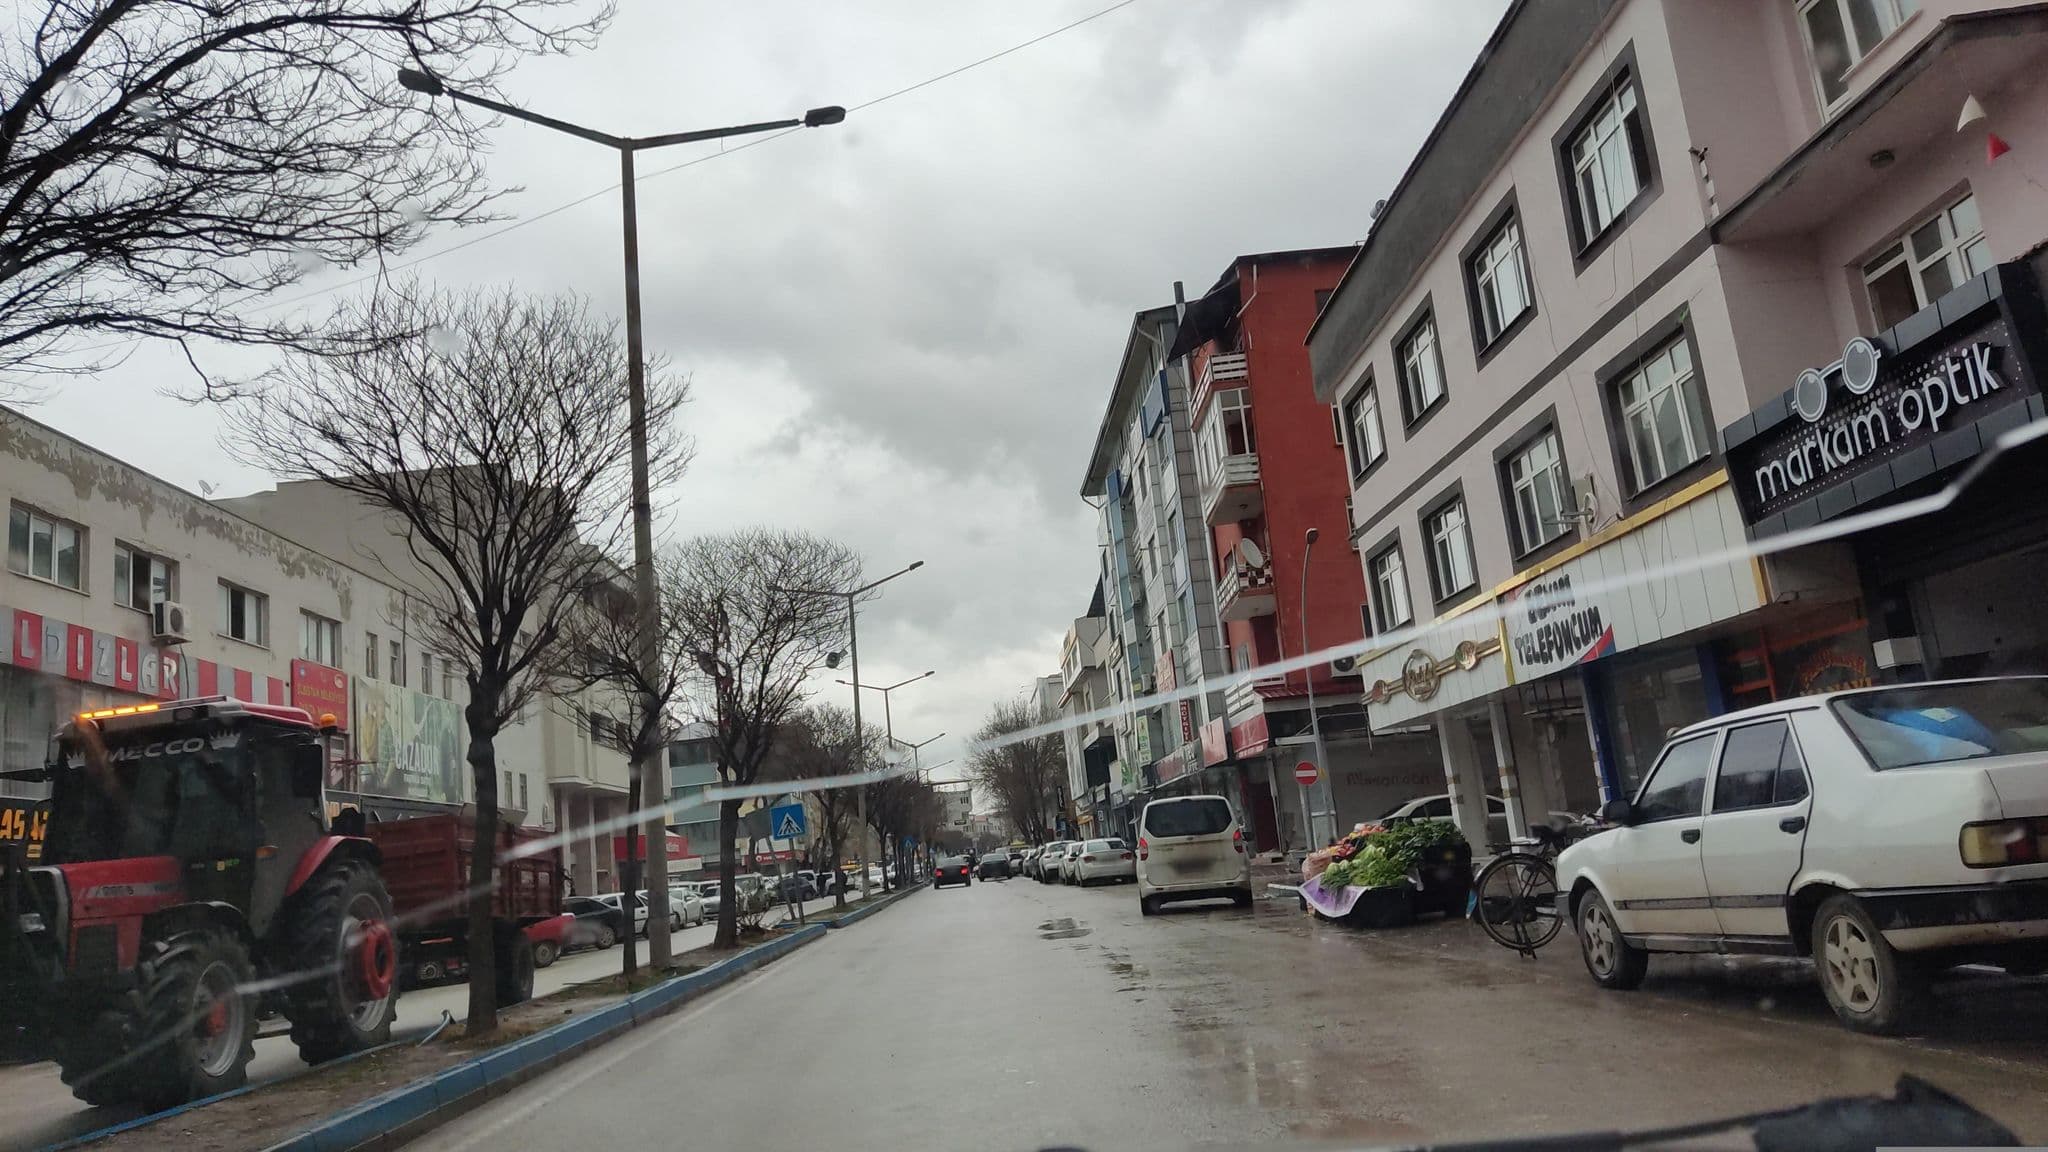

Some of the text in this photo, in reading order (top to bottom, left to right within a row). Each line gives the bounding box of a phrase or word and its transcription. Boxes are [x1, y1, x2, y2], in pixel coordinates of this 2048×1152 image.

[1755, 343, 2000, 502] markam optik
[1514, 606, 1604, 666] TELEFONCUM
